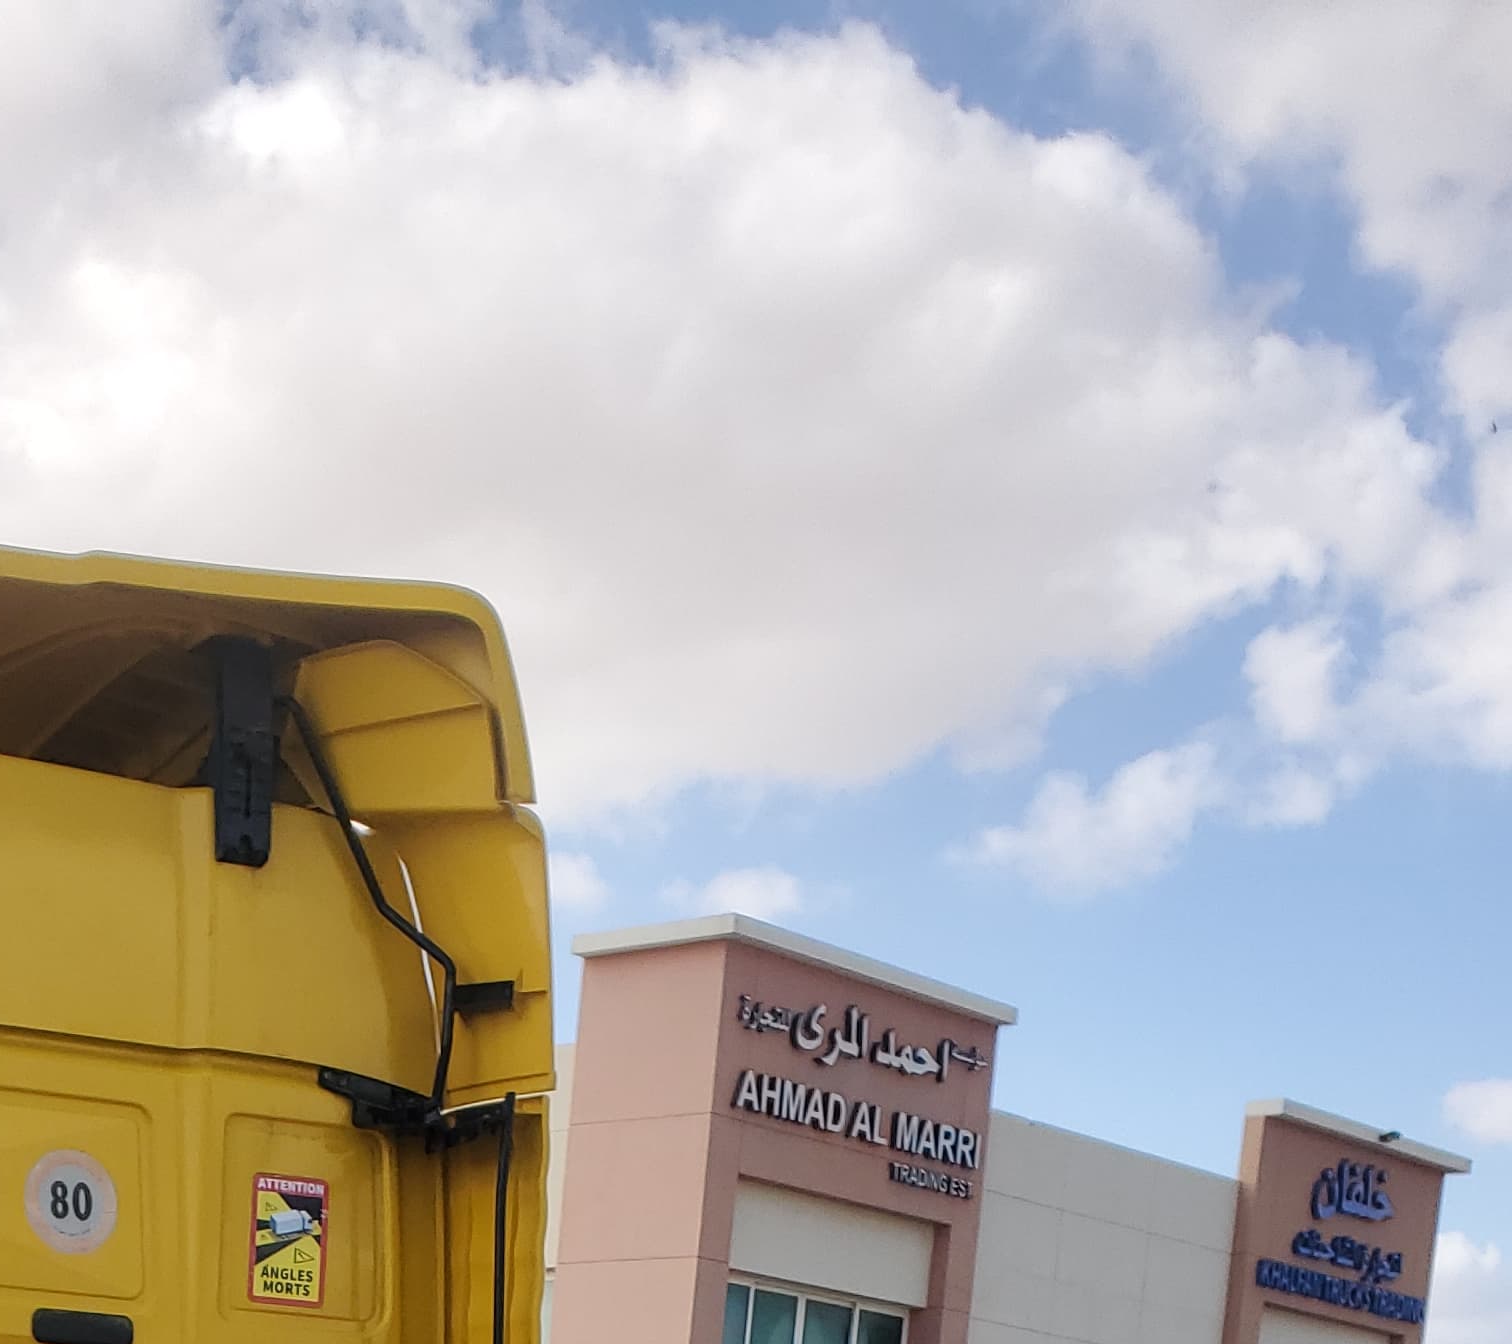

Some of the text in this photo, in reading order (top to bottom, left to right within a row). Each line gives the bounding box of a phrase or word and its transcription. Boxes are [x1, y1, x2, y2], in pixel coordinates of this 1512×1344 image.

[737, 1070, 982, 1169] AHMAD AL MARRI
[257, 1177, 325, 1196] ATTENTION
[892, 1162, 949, 1193] TRADING
[50, 1180, 94, 1222] 80
[261, 1266, 313, 1281] ANGLES
[263, 1282, 311, 1296] MORTS
